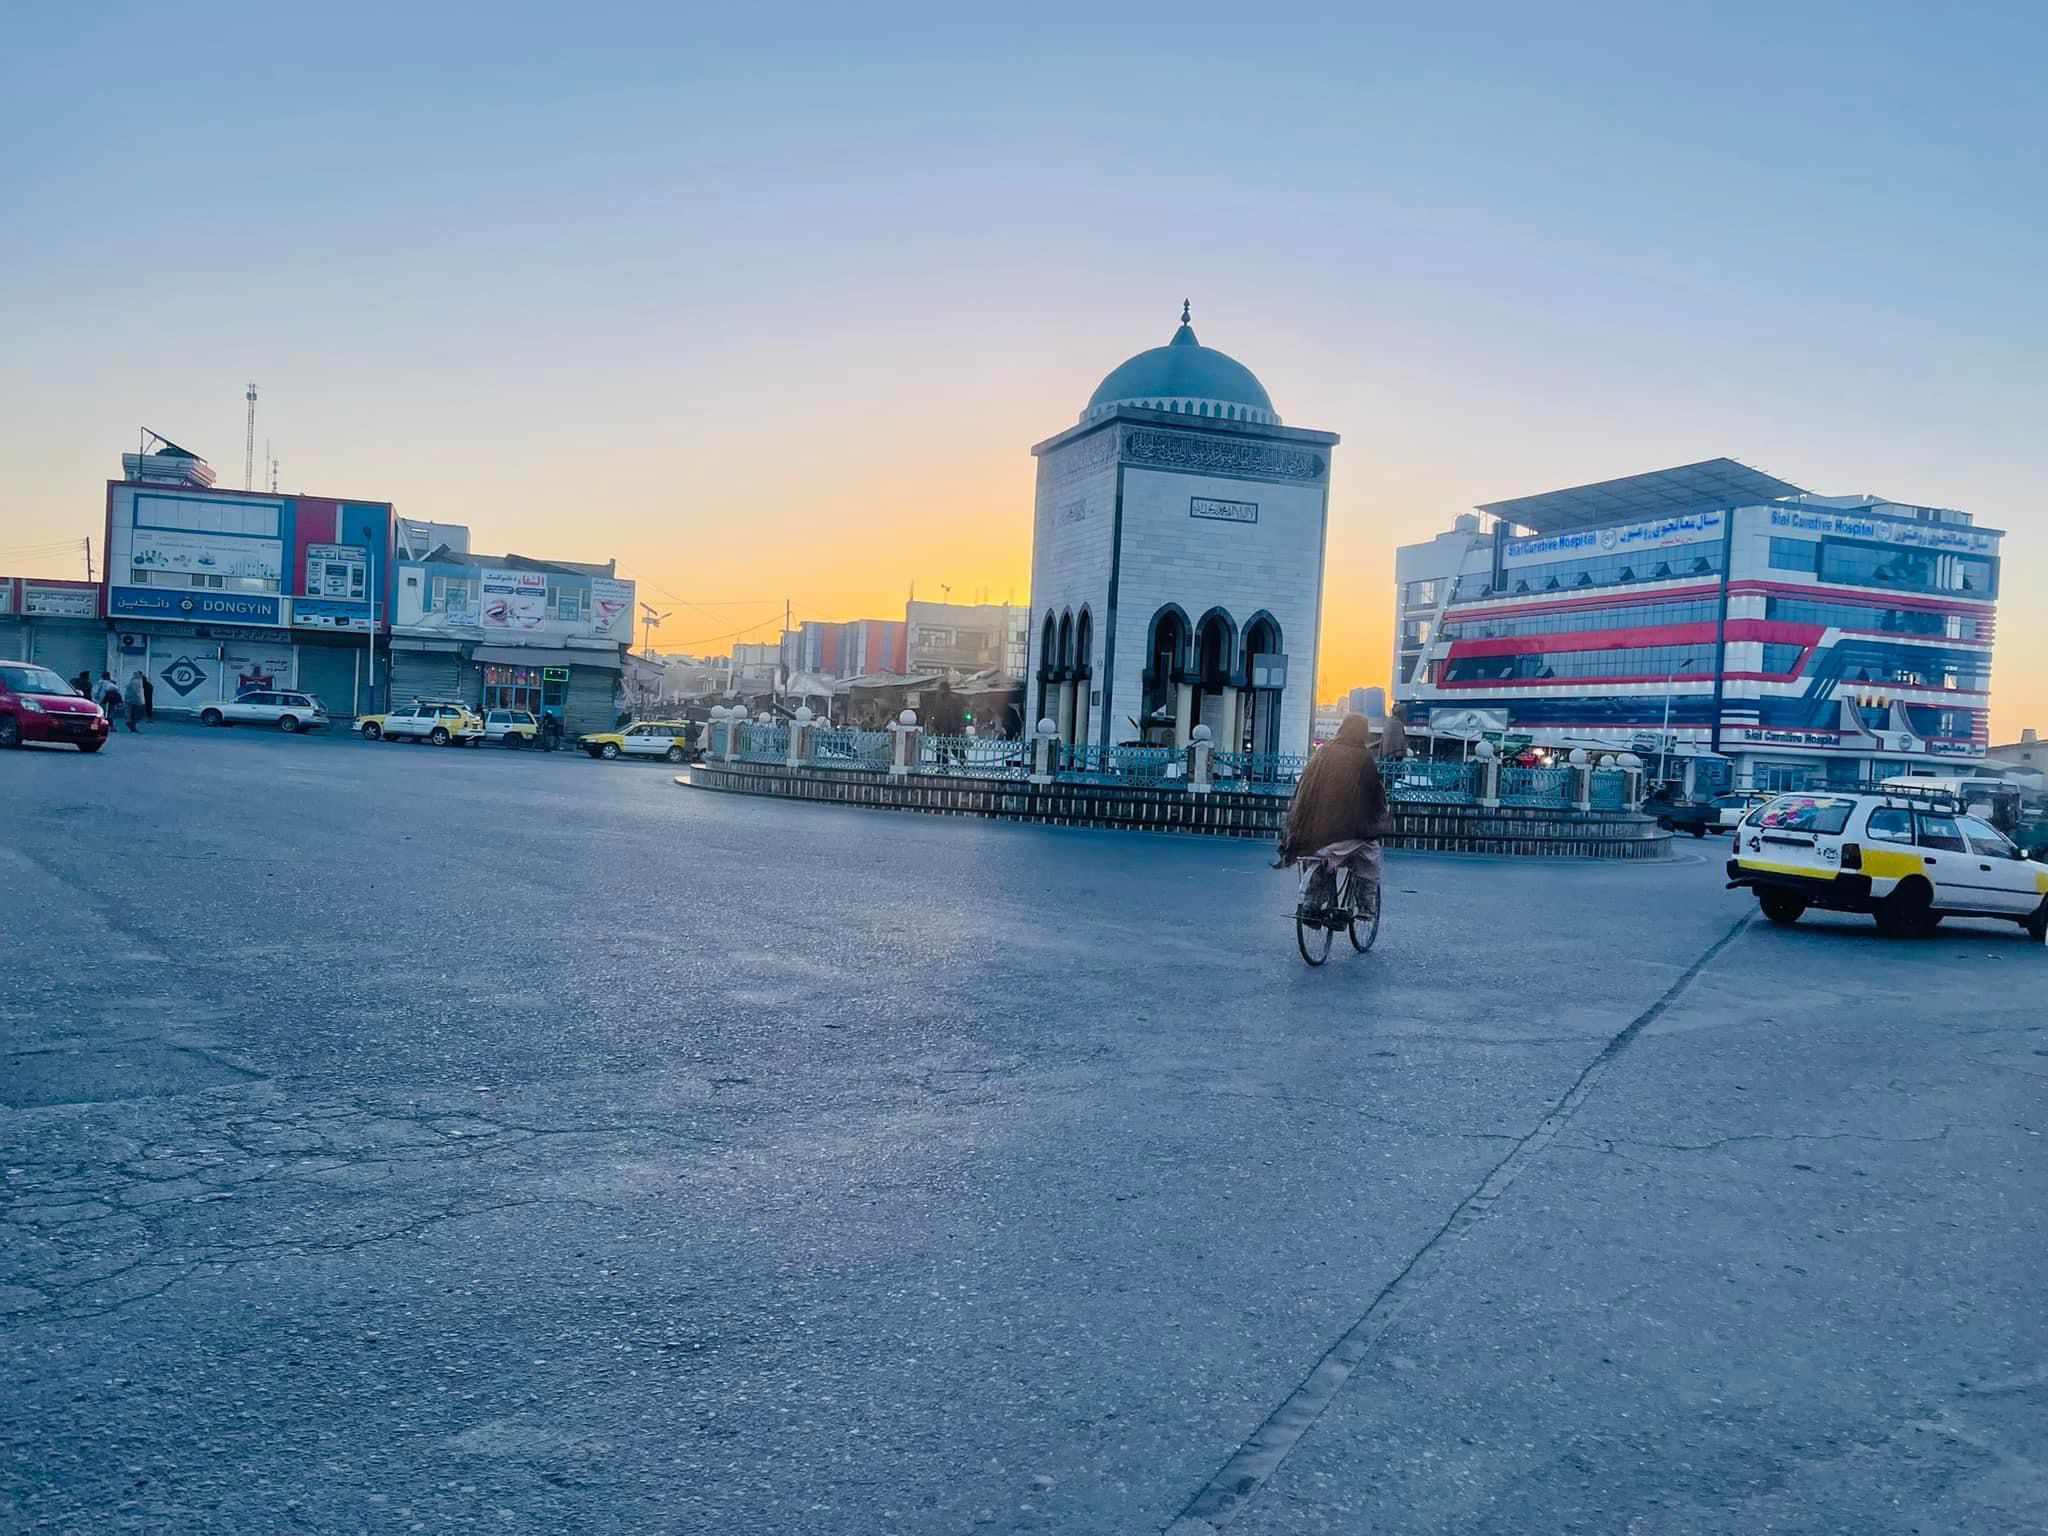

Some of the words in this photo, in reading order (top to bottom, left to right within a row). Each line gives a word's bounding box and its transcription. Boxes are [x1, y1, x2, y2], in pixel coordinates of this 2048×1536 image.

[1772, 511, 1789, 526] Sial
[1835, 520, 1875, 537] Hospital
[1559, 532, 1597, 549] Hospital
[203, 600, 272, 615] DONGYIN
